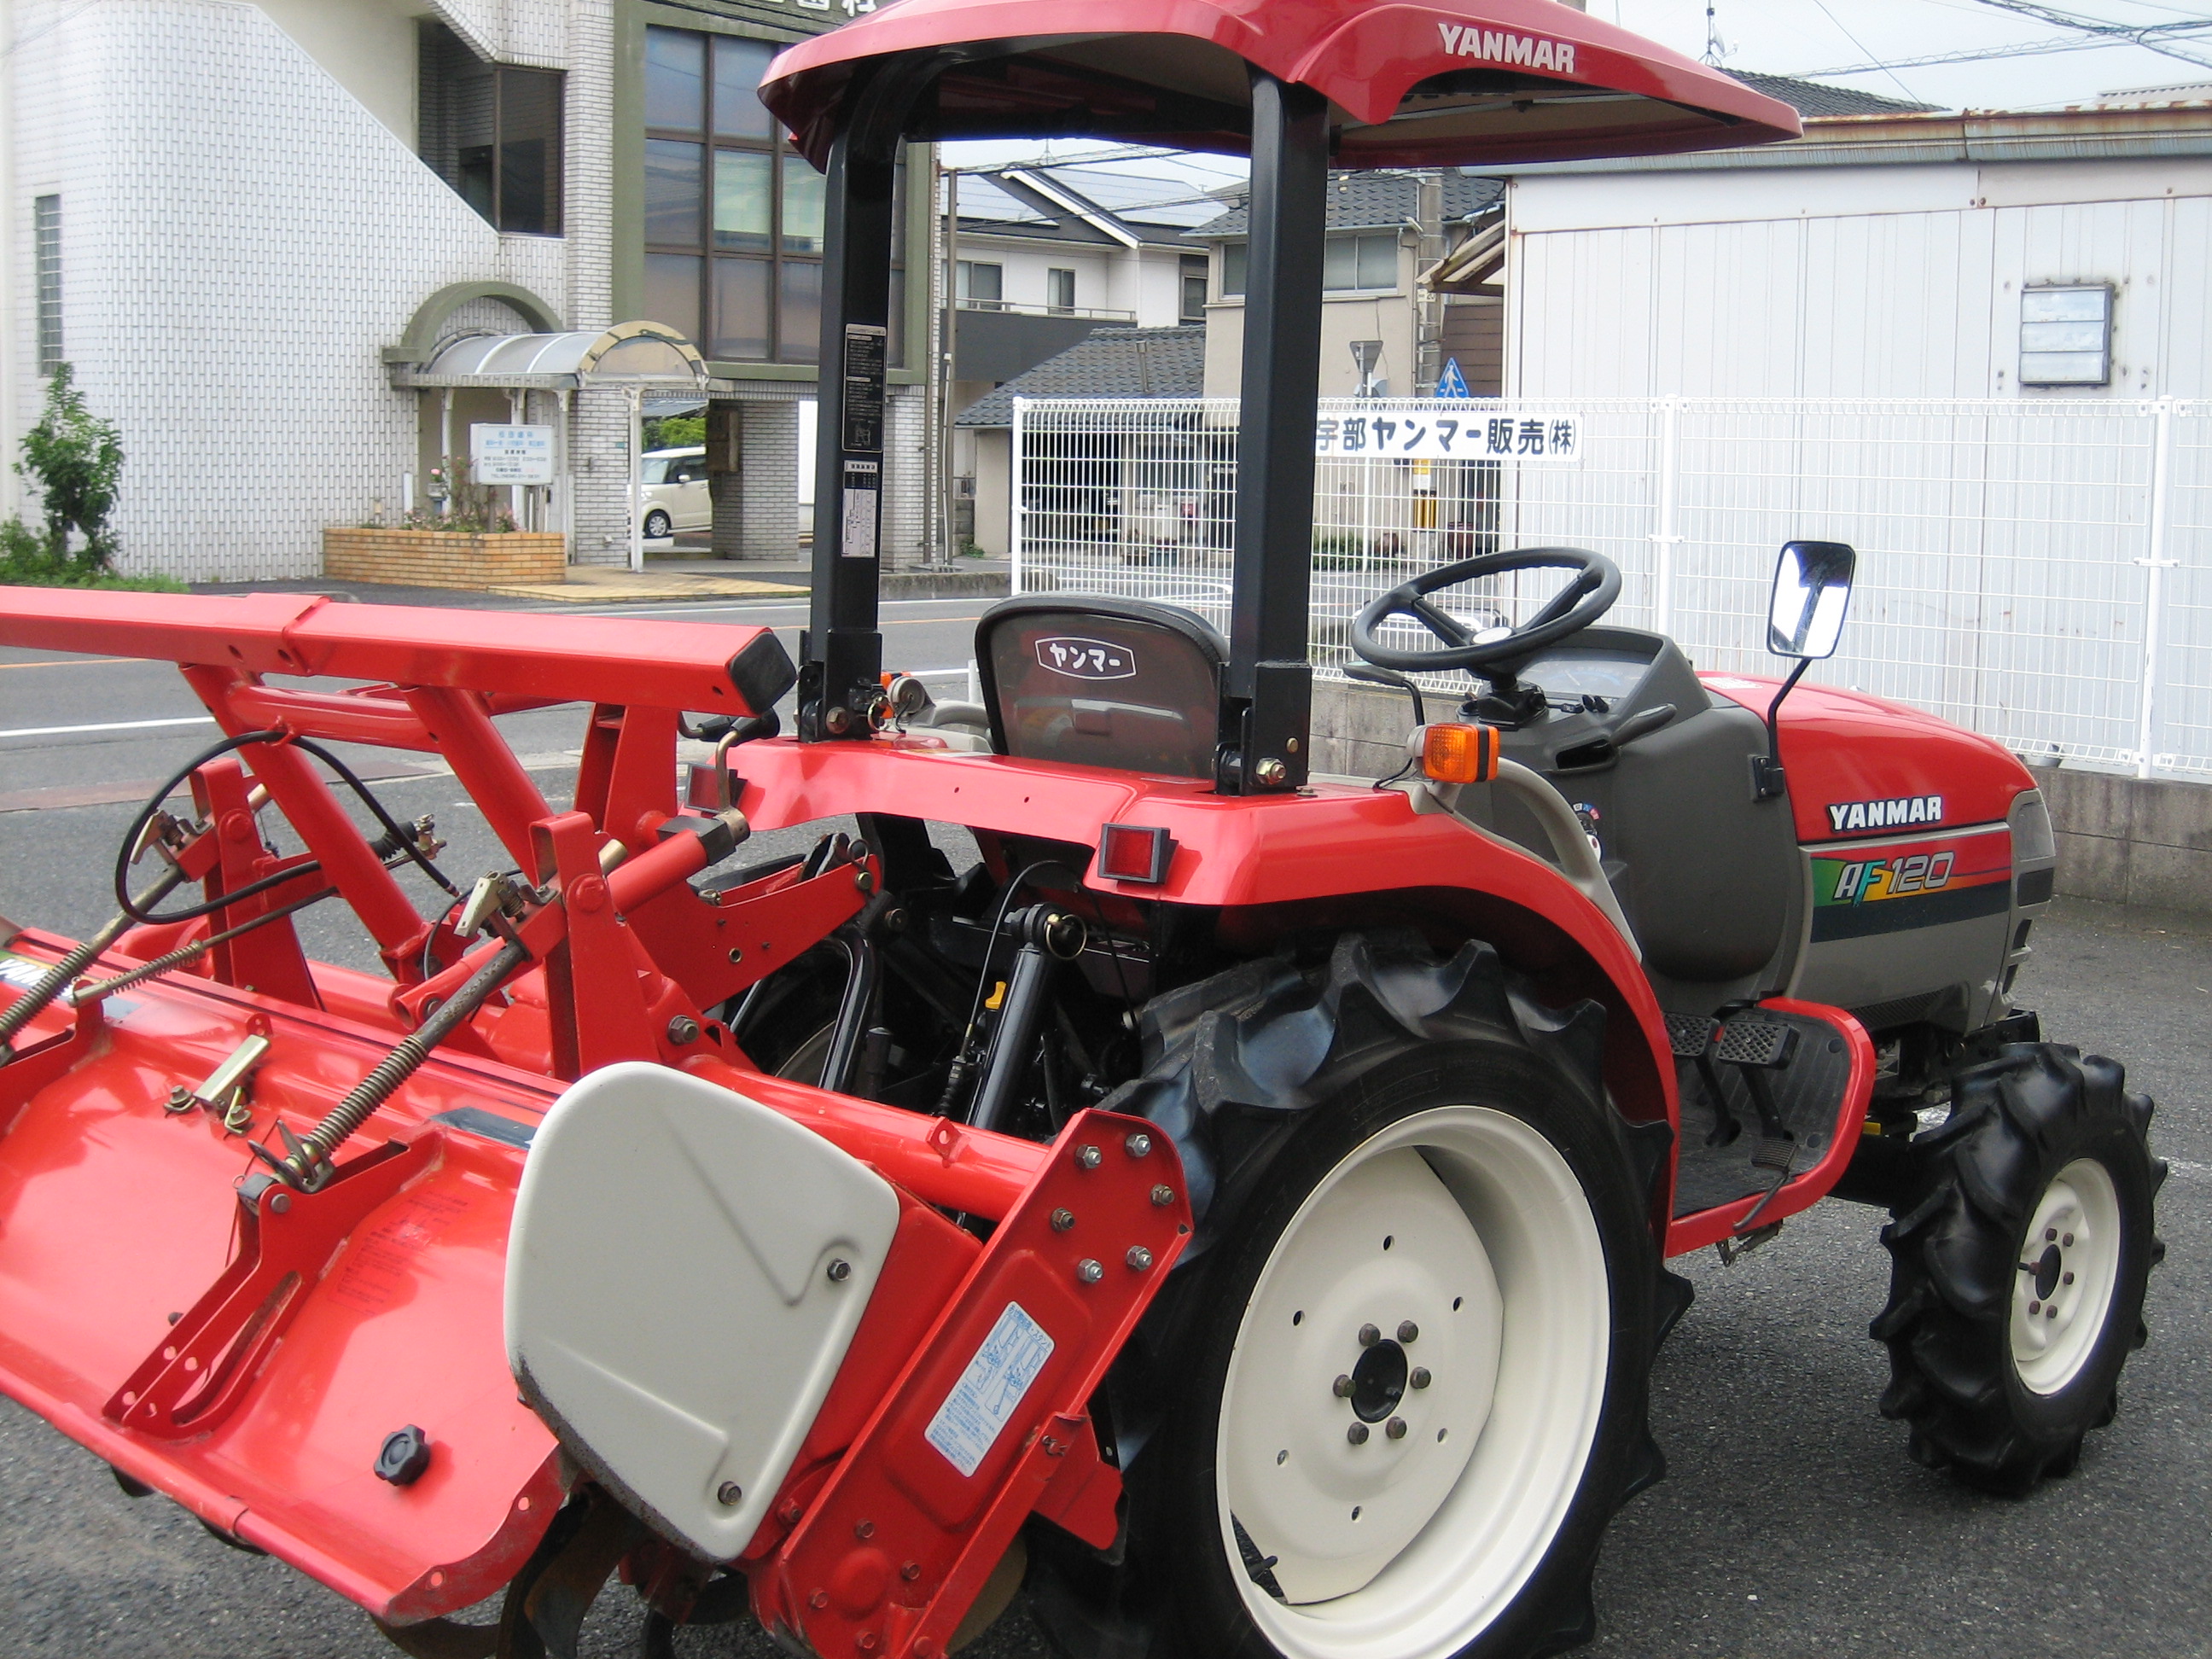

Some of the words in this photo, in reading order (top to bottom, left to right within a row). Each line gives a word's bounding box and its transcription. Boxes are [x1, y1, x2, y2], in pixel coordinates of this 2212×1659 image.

[1438, 22, 1575, 73] YANMAR
[1049, 643, 1121, 672] ヤンマー
[1829, 795, 1942, 831] YANMAR
